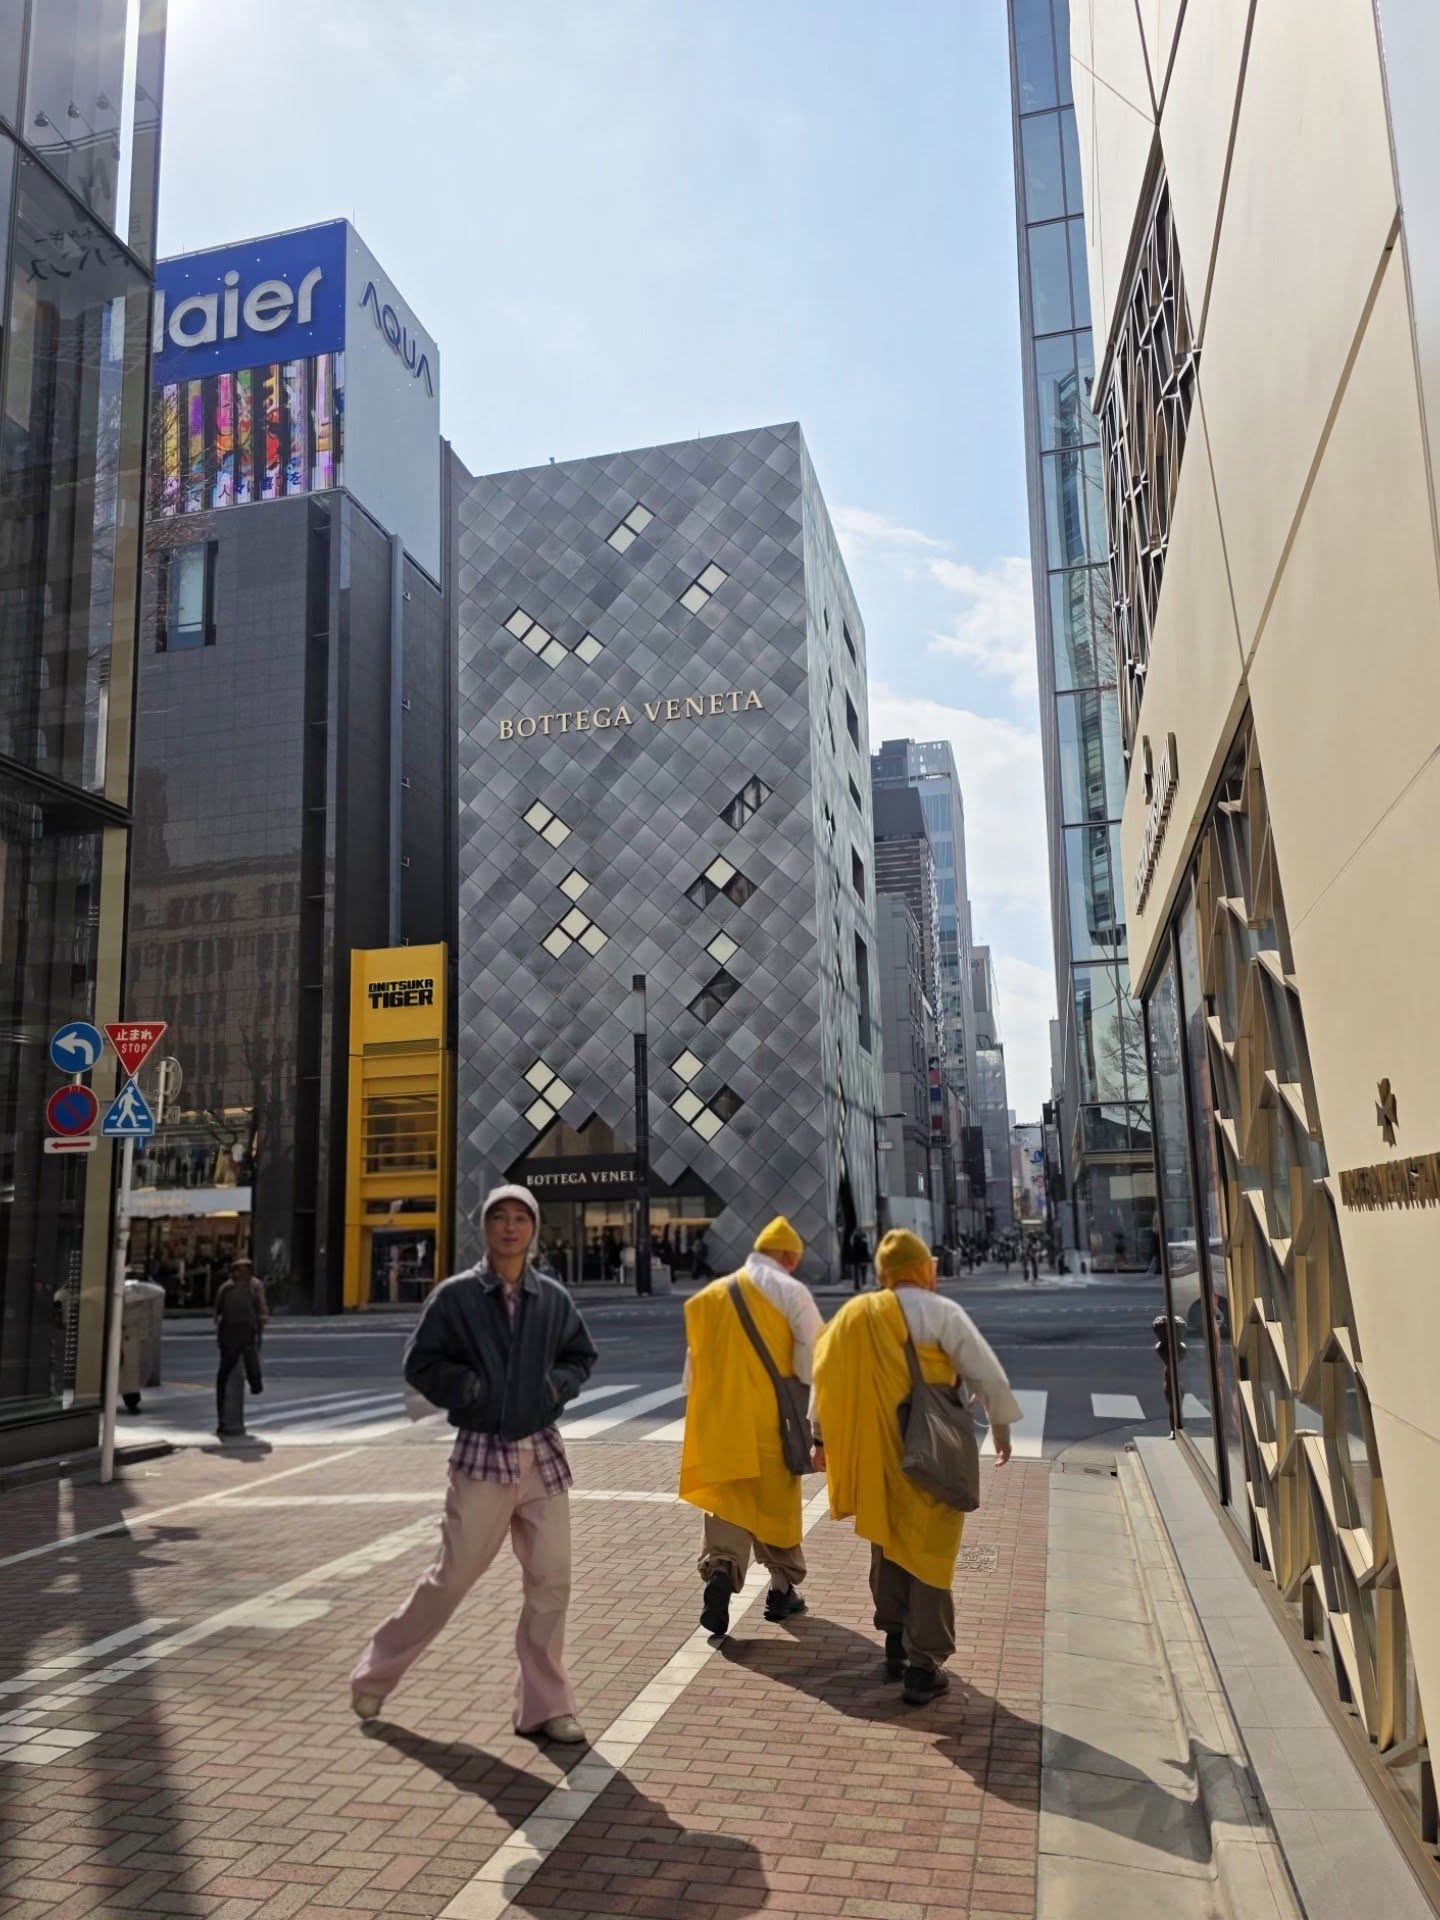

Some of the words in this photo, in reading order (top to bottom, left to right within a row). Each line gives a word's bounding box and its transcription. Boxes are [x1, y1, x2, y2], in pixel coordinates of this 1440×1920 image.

[359, 279, 434, 398] AQUA
[498, 705, 633, 741] BOTTEGA
[643, 689, 764, 724] VENETA
[368, 978, 434, 993] ONITSUKA
[368, 989, 434, 1009] TIGER
[116, 1029, 153, 1042] 止まれ
[121, 1043, 148, 1054] STOP
[526, 1173, 587, 1186] BOTTEGA
[590, 1170, 644, 1183] VENET
